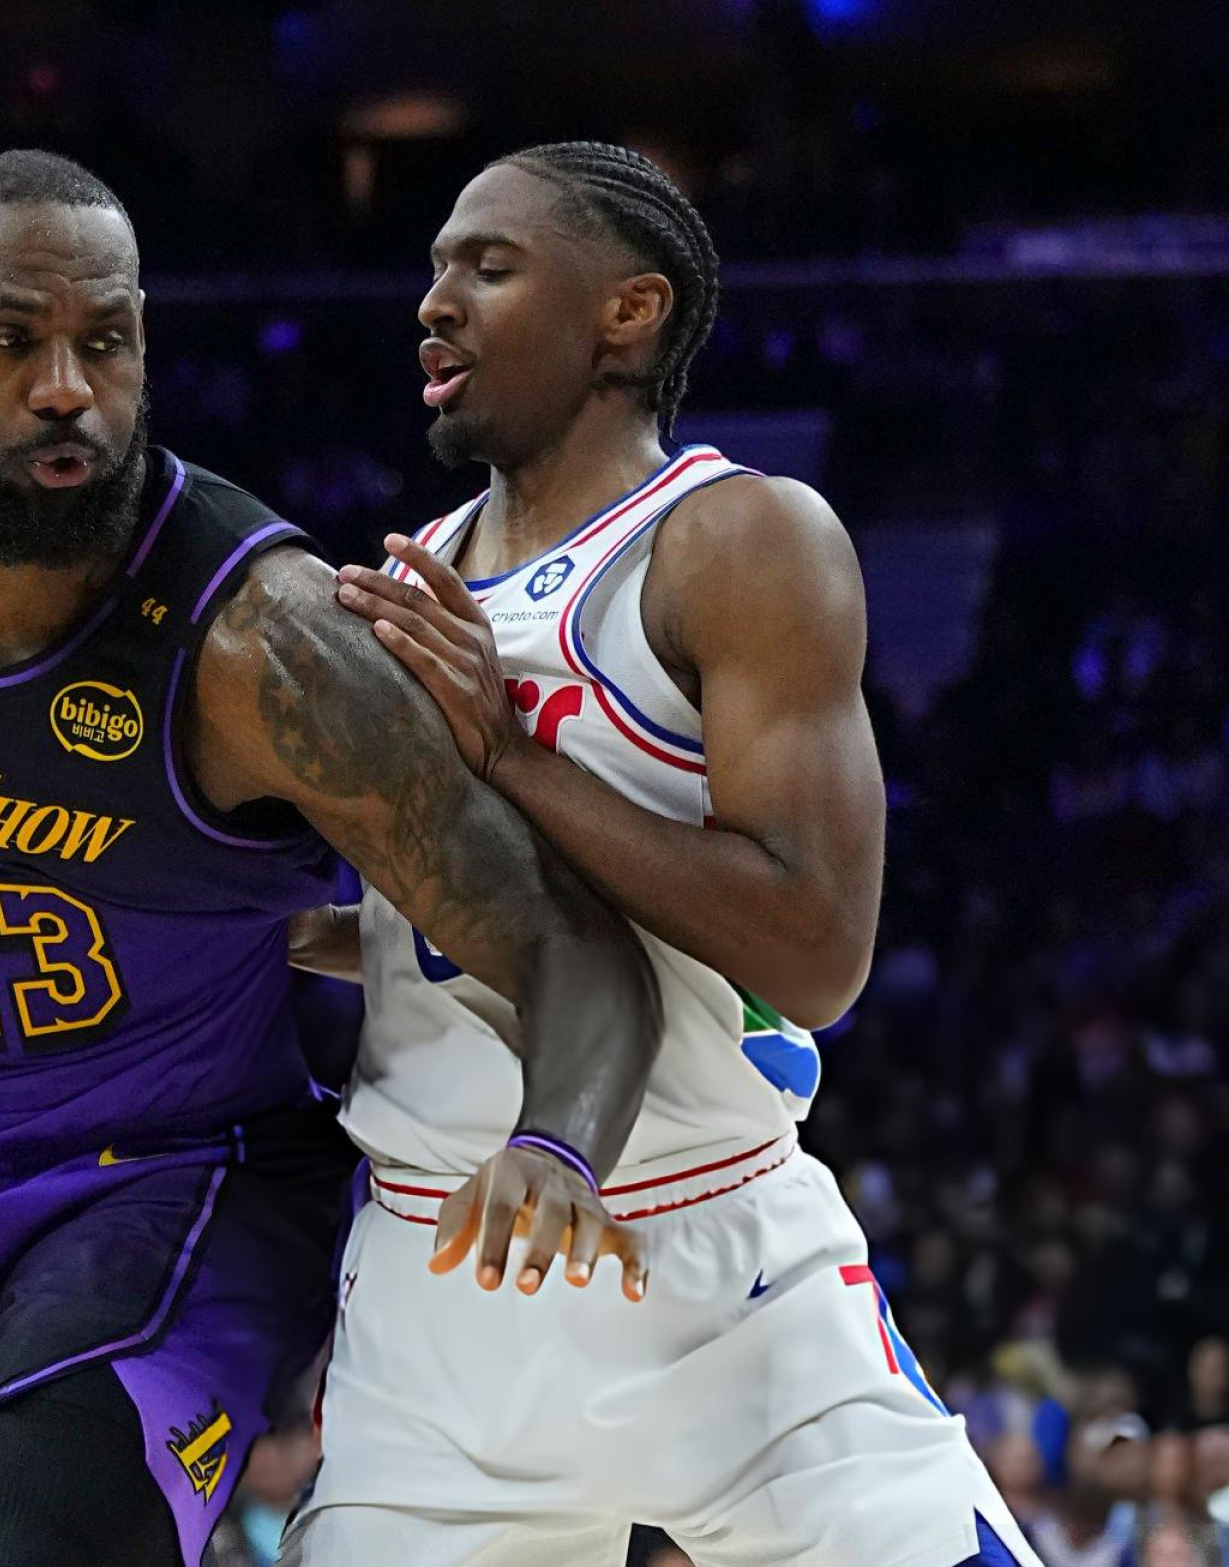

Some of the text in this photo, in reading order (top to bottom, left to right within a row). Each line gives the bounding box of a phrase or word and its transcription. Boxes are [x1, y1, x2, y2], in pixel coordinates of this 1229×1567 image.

[141, 598, 168, 625] 44
[491, 609, 560, 625] crypto.com
[60, 696, 139, 742] bibigo
[72, 723, 105, 743] 비비고
